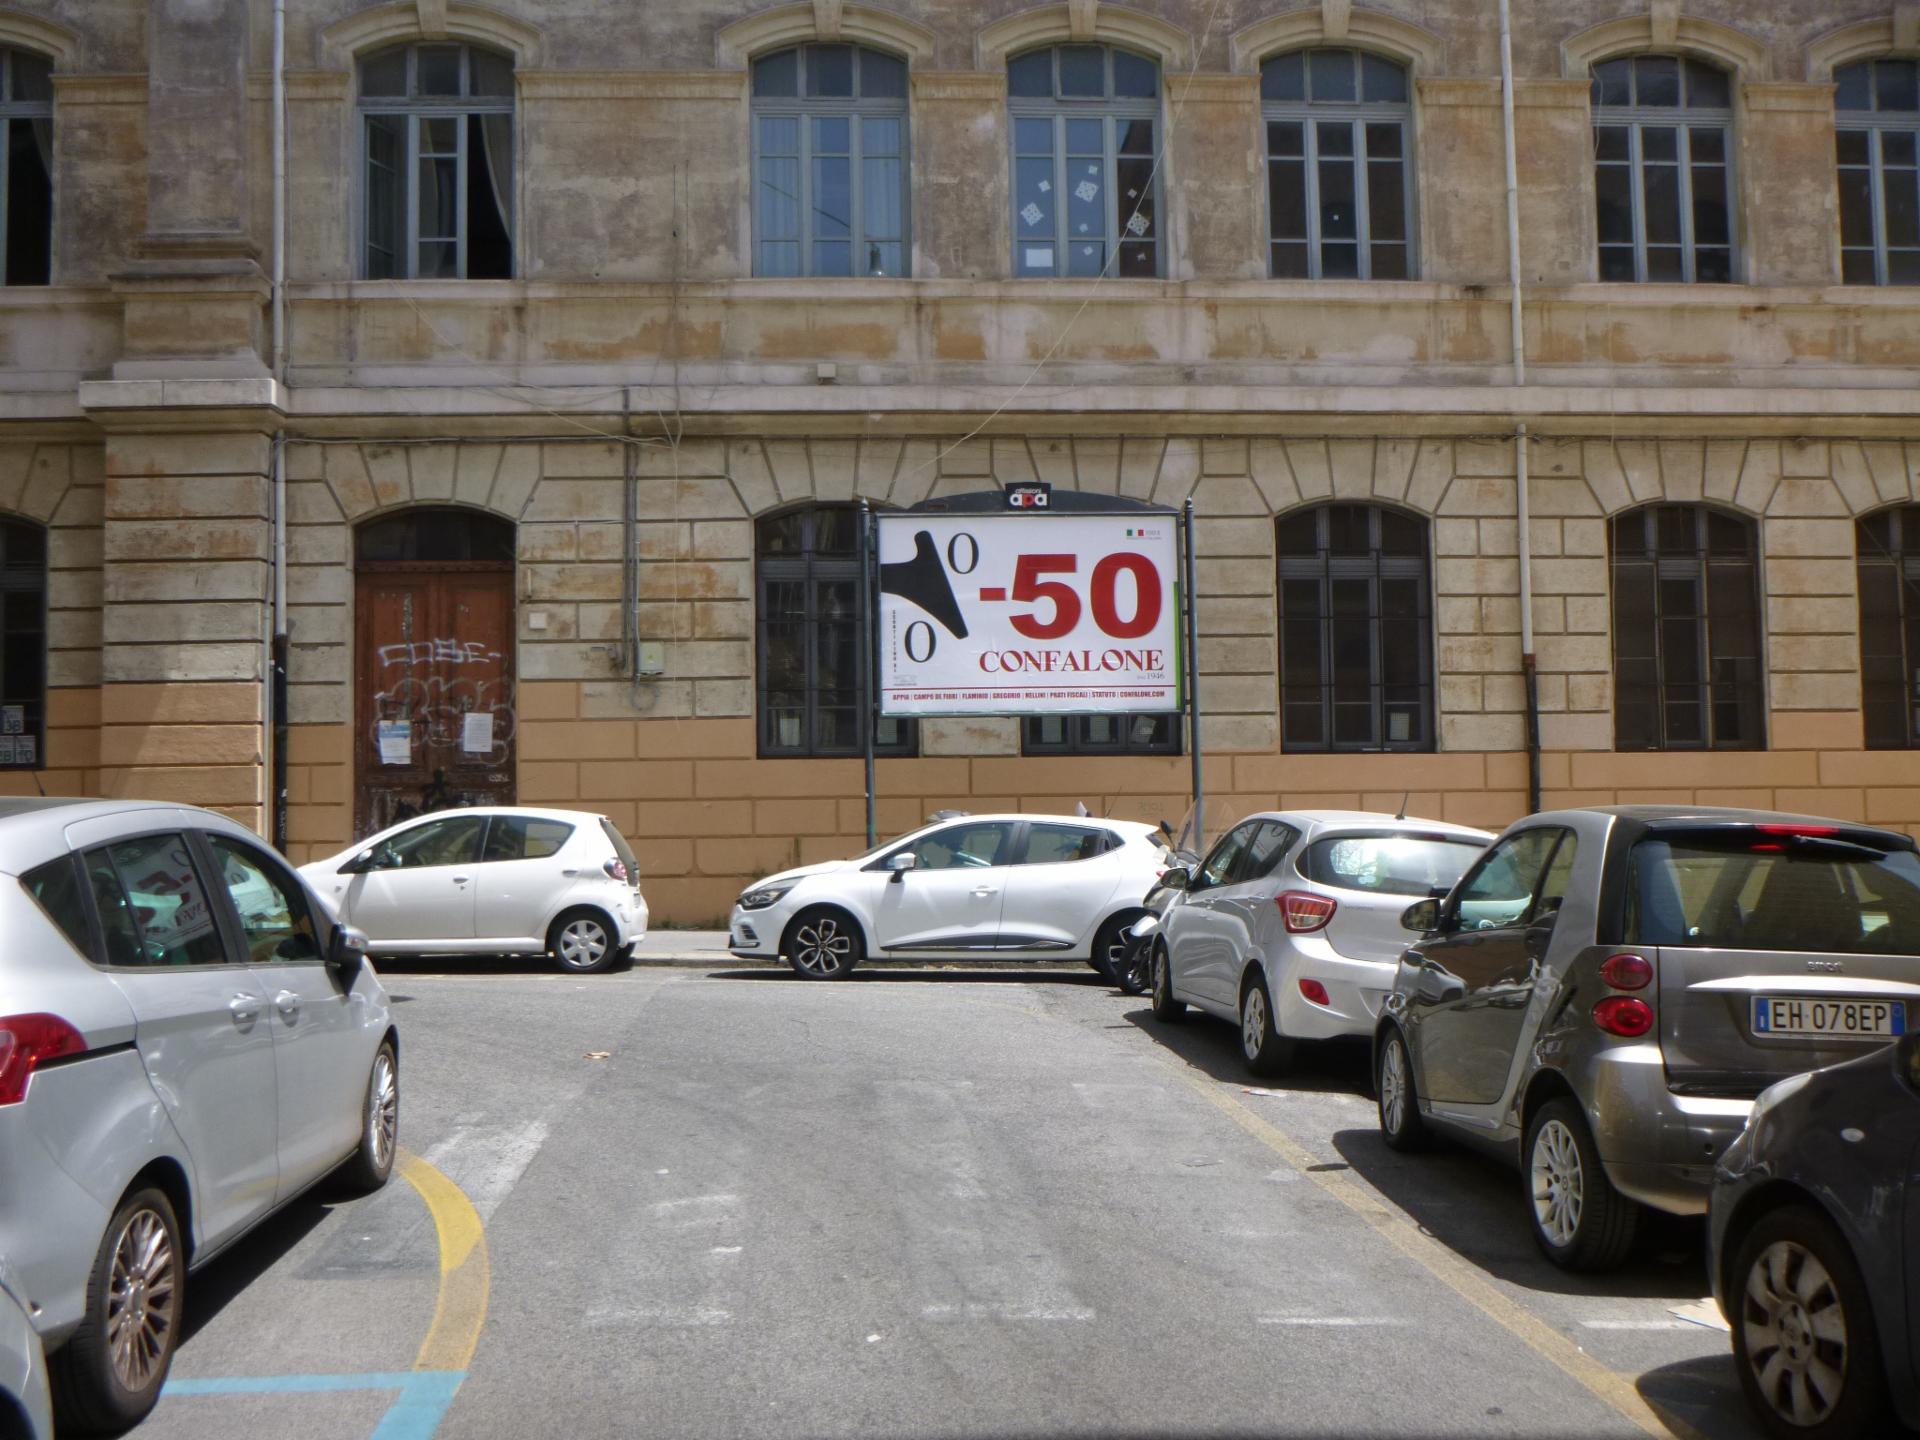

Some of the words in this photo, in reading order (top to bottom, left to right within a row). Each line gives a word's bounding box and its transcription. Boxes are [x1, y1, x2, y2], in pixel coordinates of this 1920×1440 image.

[1010, 493, 1047, 508] apa
[979, 649, 1165, 672] CONFALONE
[1147, 672, 1165, 680] 1946
